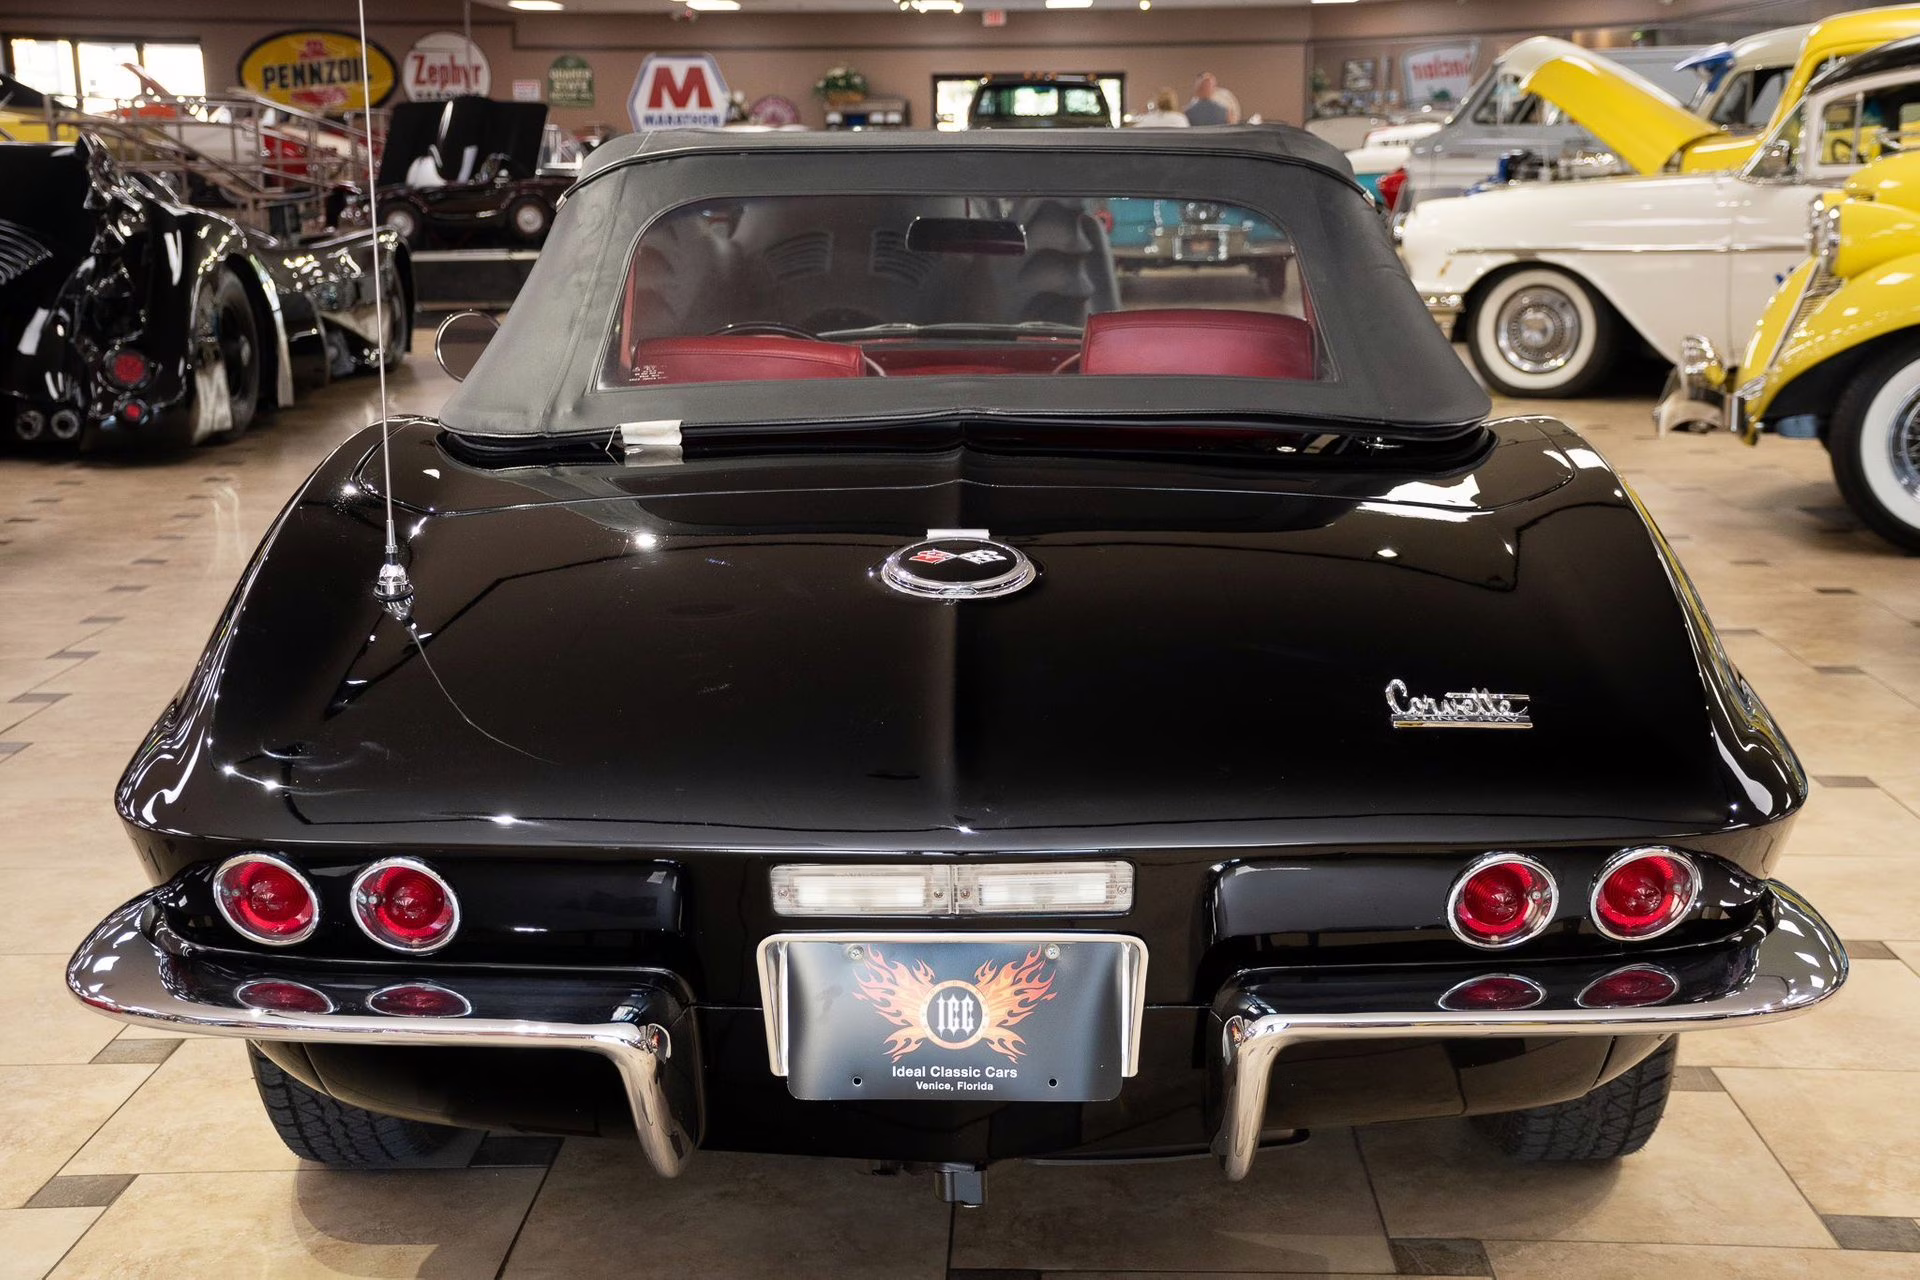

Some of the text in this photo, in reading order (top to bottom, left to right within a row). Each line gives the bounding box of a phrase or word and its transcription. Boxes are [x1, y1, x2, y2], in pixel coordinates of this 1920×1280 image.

[262, 57, 374, 91] PENNZOIL
[412, 54, 482, 90] Zephyr
[648, 66, 714, 109] M
[644, 114, 721, 127] MARATHON
[1385, 678, 1531, 717] Corvette
[892, 1065, 1018, 1078] Ideal Classic Cars
[916, 1081, 994, 1091] Venice, Florida
